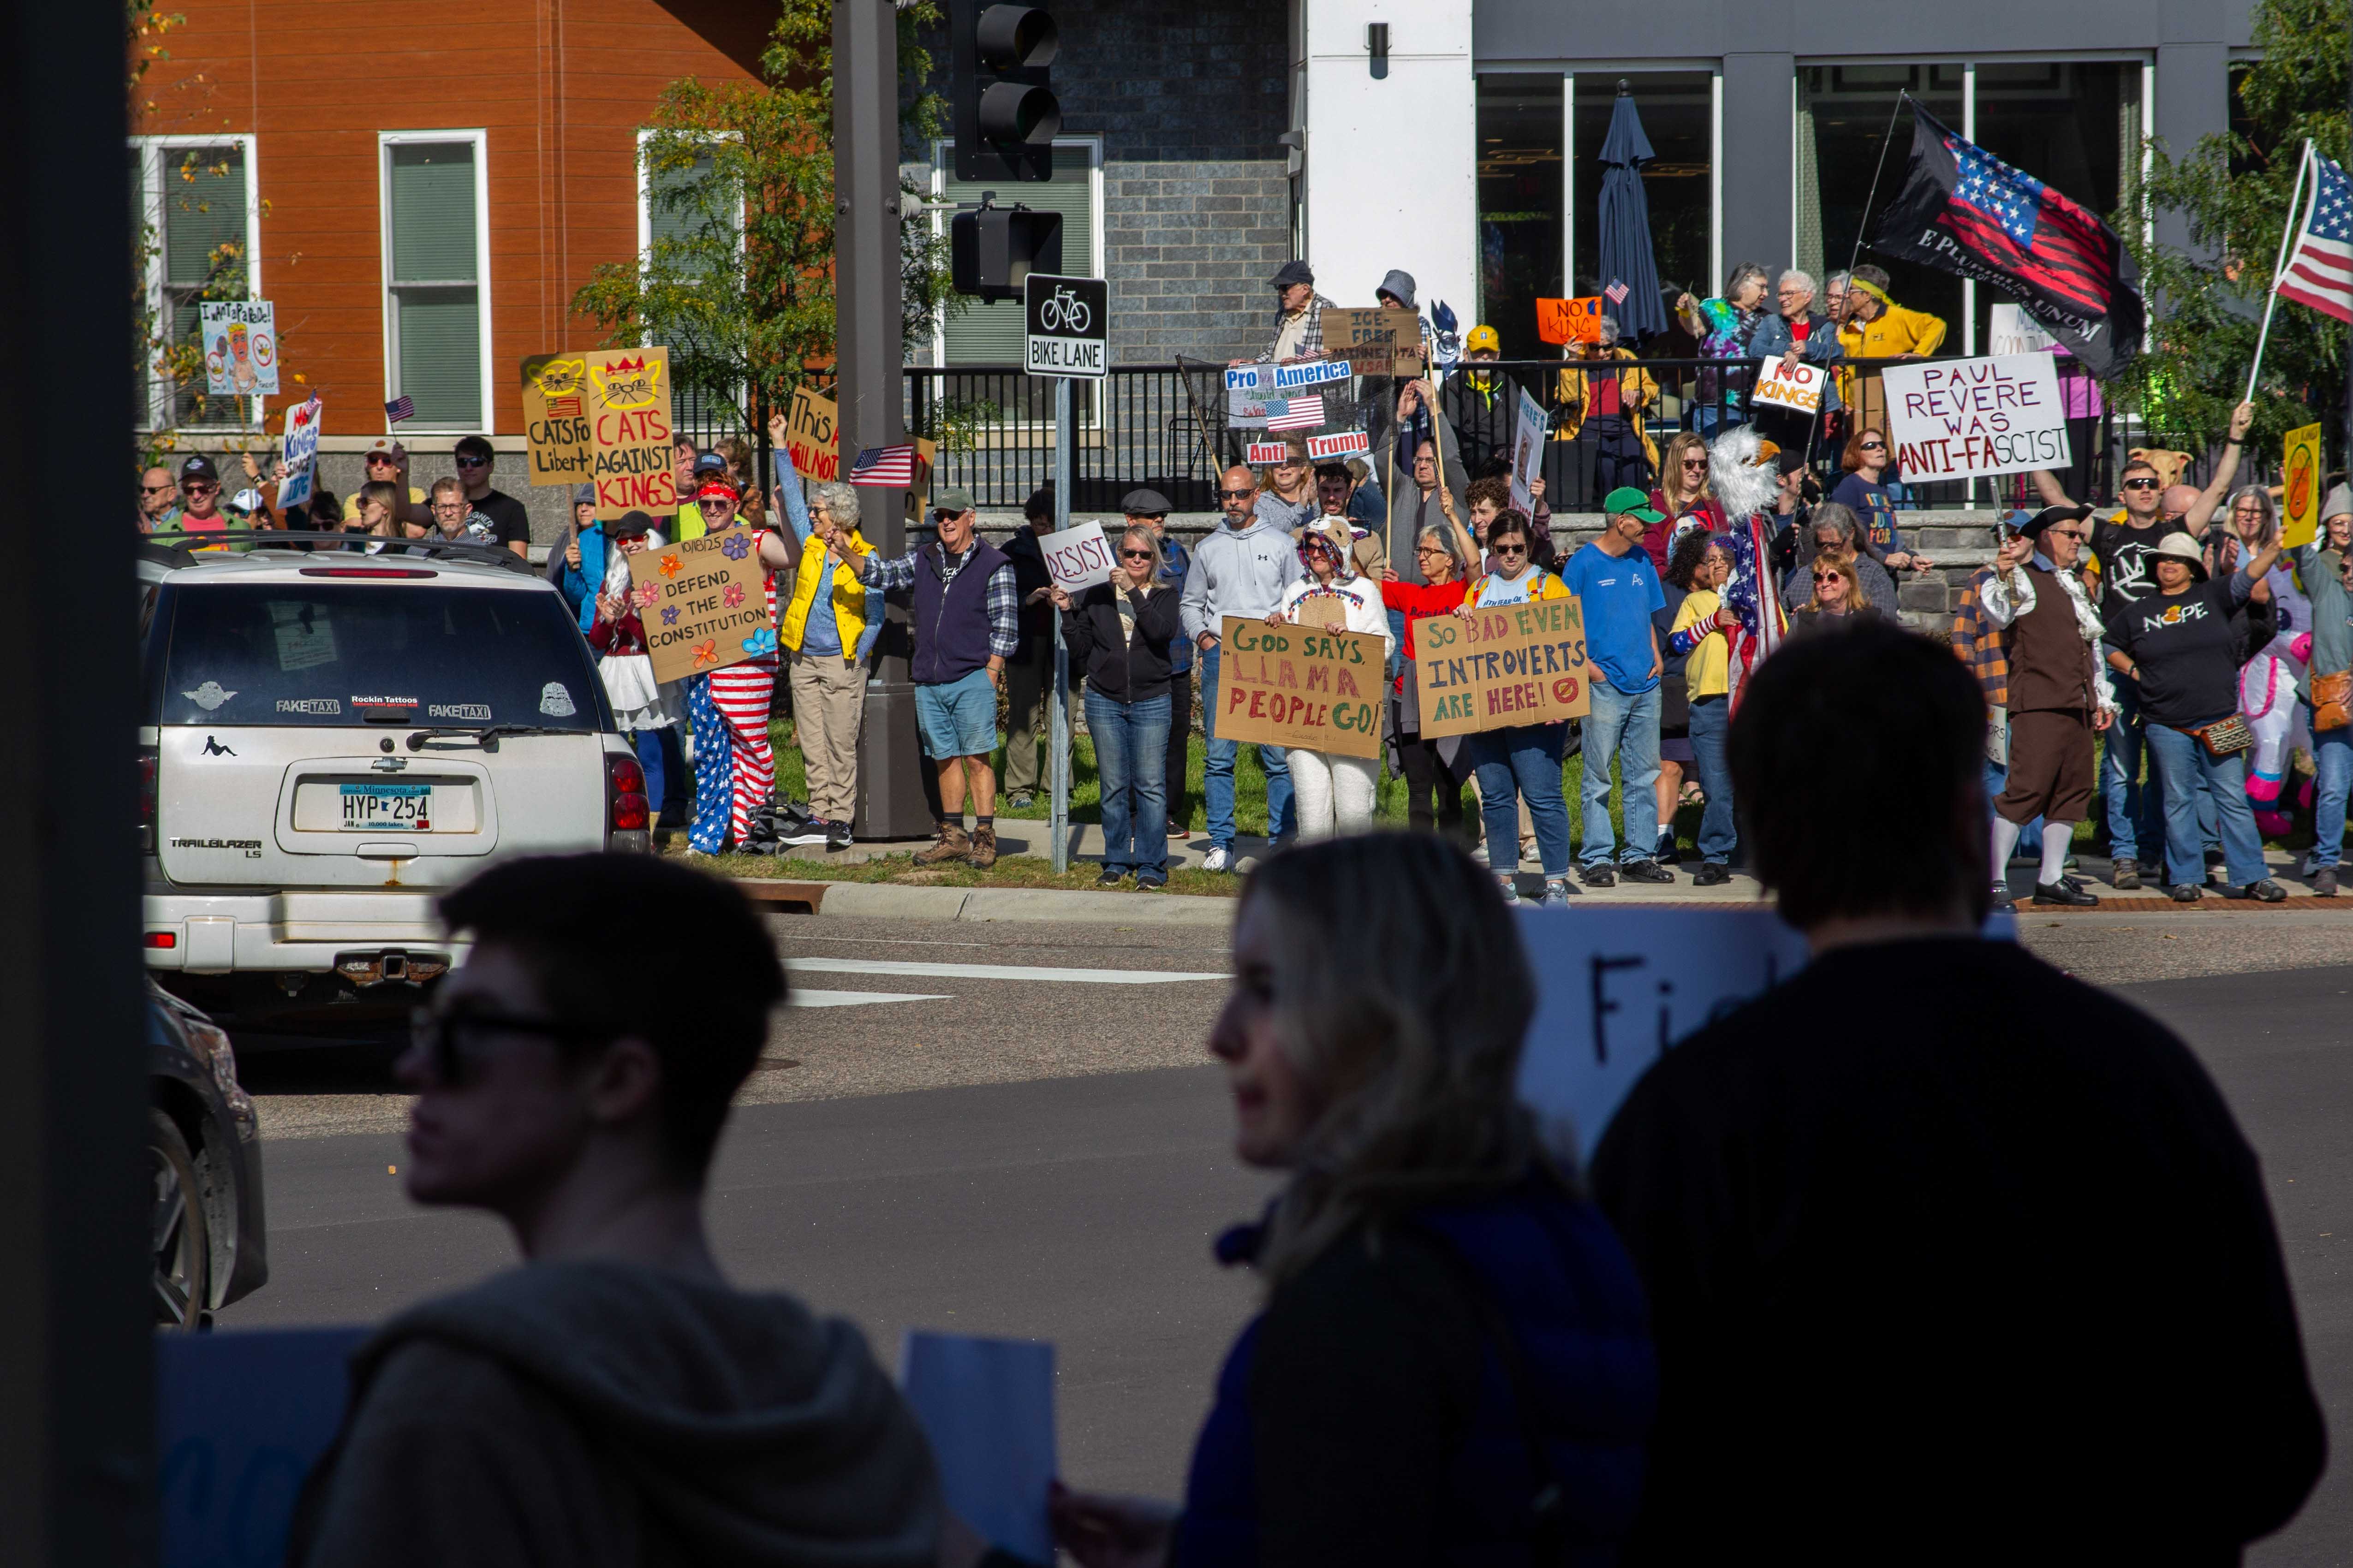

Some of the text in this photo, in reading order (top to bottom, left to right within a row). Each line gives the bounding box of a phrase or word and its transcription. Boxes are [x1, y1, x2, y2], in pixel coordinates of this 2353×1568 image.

[1918, 229, 1937, 246] E
[2034, 299, 2103, 342] UNUM
[1351, 311, 1390, 326] ICE-
[1557, 302, 1582, 317] NO
[1352, 328, 1392, 343] FREE
[1548, 317, 1591, 334] KING
[1031, 340, 1101, 368] BIKE LANE
[1227, 370, 1257, 388] Pro
[1276, 361, 1350, 387] America
[1774, 362, 1813, 384] NO
[1924, 363, 2013, 389] PAUL
[1754, 379, 1820, 409] KINGS
[1905, 381, 2041, 418] REVERE
[530, 416, 591, 445] CATS Fo
[596, 410, 669, 446] CATS
[794, 393, 831, 443] This
[1943, 412, 2010, 436] WAS
[1250, 443, 1285, 462] Anti
[1308, 432, 1368, 456] Trump
[1896, 427, 2065, 476] ANTI-FASCIST
[595, 446, 672, 475] AGAINST
[810, 448, 839, 482] NOT
[597, 472, 677, 508] KINGS
[681, 537, 721, 553] 10/18/25
[1046, 537, 1108, 583] RESIST
[666, 570, 730, 597] DEFEND
[686, 596, 718, 615] THE
[649, 607, 766, 647] CONSTITUTION
[1465, 614, 1508, 643] BAD
[1515, 604, 1580, 636] EVEN
[1304, 636, 1365, 665] SAYS,
[1428, 640, 1585, 689] INTROVERTS
[1229, 687, 1328, 726] PEOPLE
[1433, 681, 1546, 722] ARE HERE!
[344, 796, 427, 819] HYP 254
[169, 837, 262, 849] TRAILBLAZER
